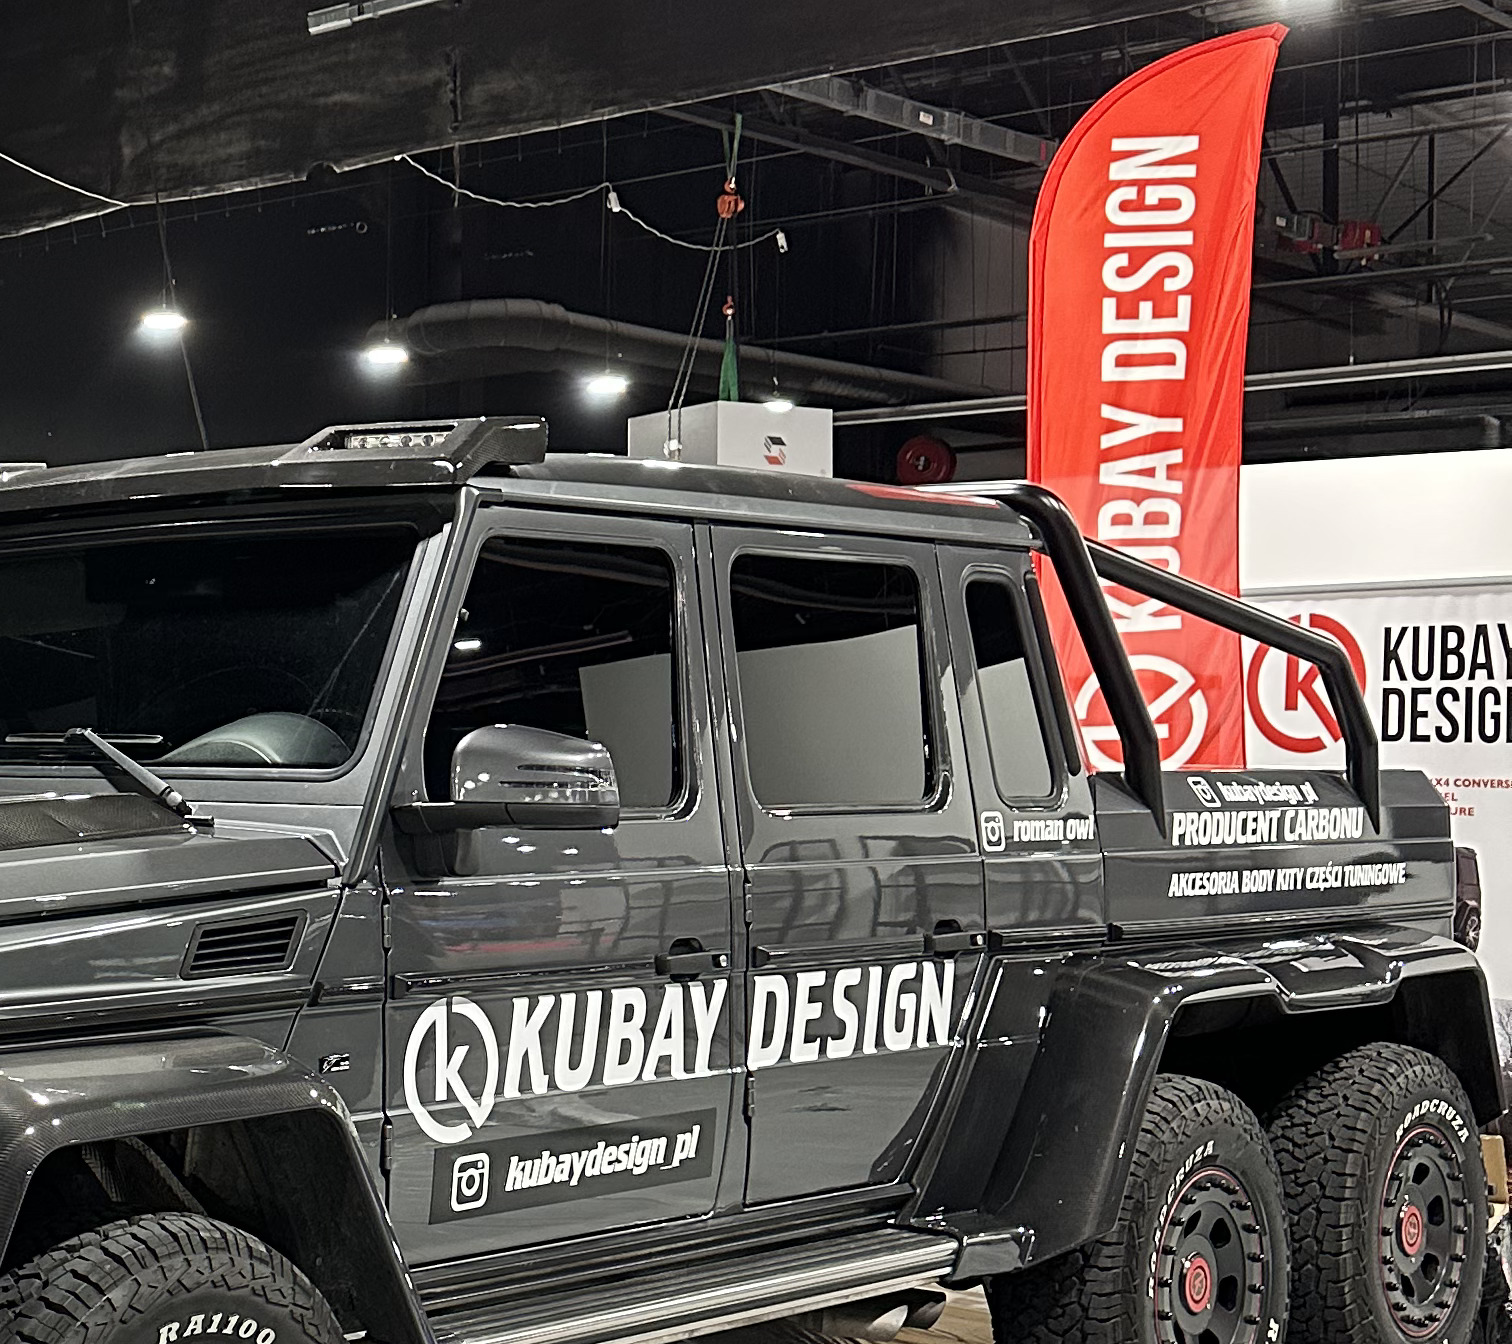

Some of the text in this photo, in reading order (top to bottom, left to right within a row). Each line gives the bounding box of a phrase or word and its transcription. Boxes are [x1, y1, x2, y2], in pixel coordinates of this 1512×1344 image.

[1101, 134, 1201, 384] DESIGN
[1382, 622, 1512, 682] KUBAY
[1381, 685, 1512, 744] DESIG
[1429, 777, 1512, 789] X4 CONVERS
[1013, 814, 1095, 845] roman_owl
[1171, 806, 1364, 846] PRODUCENT CARBONU
[1167, 861, 1407, 897] AKCESORIA BODY KITY CZĘŚCI TUNINGOWE
[503, 959, 956, 1098] KUBAY DESIGN
[1394, 1098, 1470, 1144] ROADCRUZA
[504, 1124, 701, 1193] kubaydesign_pl
